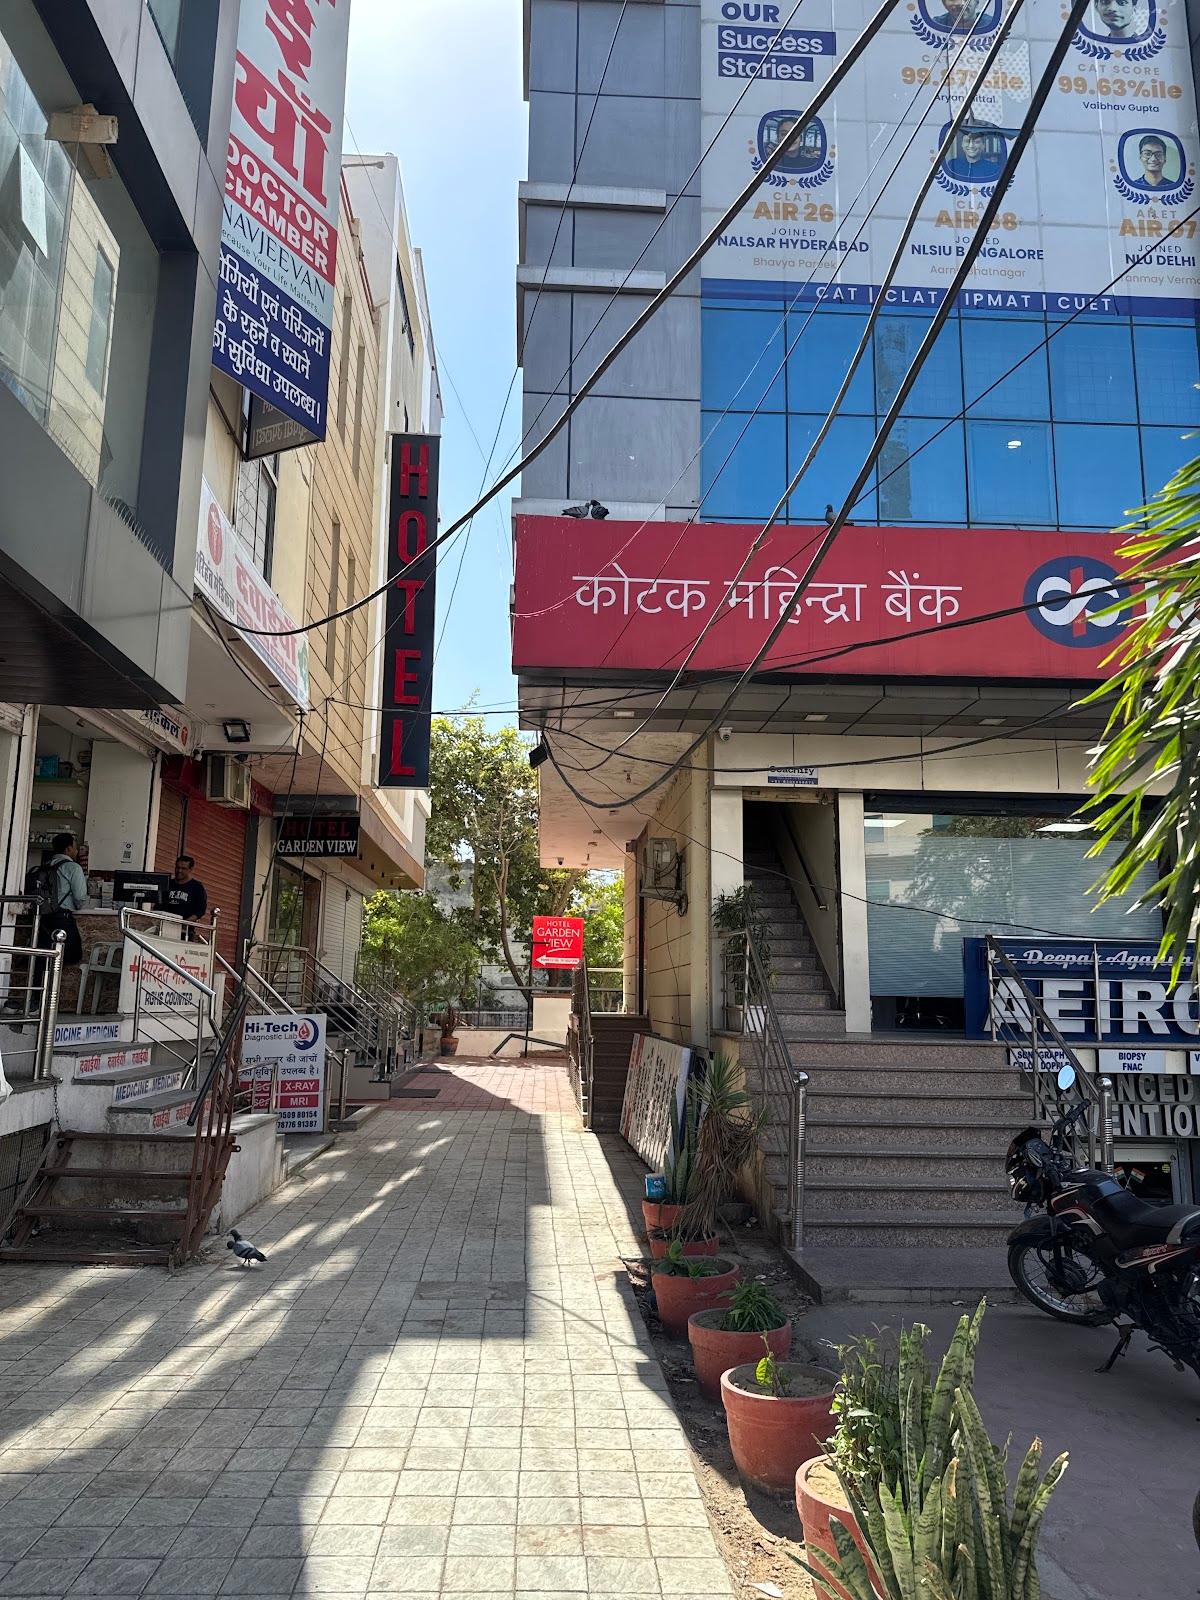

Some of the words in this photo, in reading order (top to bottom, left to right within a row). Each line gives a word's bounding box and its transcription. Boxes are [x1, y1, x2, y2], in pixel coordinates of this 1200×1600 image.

[721, 2, 780, 23] OUR
[721, 29, 824, 53] Success
[721, 57, 806, 80] Stories
[959, 56, 1008, 67] SCOE
[1078, 63, 1106, 72] CAT
[1112, 65, 1160, 75] SCORE
[1058, 75, 1183, 99] 99.63%ile
[967, 95, 996, 103] ittal
[1082, 101, 1126, 111] Vaibhav
[1128, 103, 1160, 114] Gupta
[227, 137, 329, 251] DOCTOR
[773, 192, 812, 201] CLAT
[753, 201, 799, 221] AIR
[803, 203, 834, 222] 26
[956, 200, 988, 210] CLA
[225, 170, 328, 276] CHAMBER
[934, 209, 979, 230] AIR
[771, 228, 817, 237] JOINED
[1119, 218, 1163, 238] AIR
[717, 236, 776, 249] NALSAR
[779, 238, 870, 253] HYDERABAD
[955, 236, 1000, 246] JOED
[1138, 244, 1182, 253] JOINED
[222, 200, 326, 304] NAVJEEVAN
[222, 228, 250, 256] ecause
[273, 269, 288, 286] Life
[911, 244, 952, 257] NLSIU
[956, 246, 1045, 260] BNGALORE
[1125, 253, 1153, 265] NLU
[1156, 255, 1196, 266] DELHI
[1121, 274, 1164, 286] anmay
[815, 286, 857, 300] CAT
[884, 288, 938, 304] CLAT
[965, 291, 1031, 308] IPMAT
[1057, 296, 1111, 312] CUET
[261, 290, 280, 322] एवं
[281, 305, 325, 357] परिजनों
[223, 289, 238, 324] के
[240, 310, 269, 348] रहने
[270, 332, 280, 358] व
[282, 342, 311, 380] खाने
[228, 337, 272, 387] सुविधा
[572, 561, 710, 618] कोटक
[724, 566, 867, 625] महिन्द्रा
[881, 569, 963, 624] बैंक
[391, 443, 430, 777] HOTEL
[286, 821, 350, 837] HOTEL
[276, 839, 325, 853] GARDEN
[326, 840, 357, 853] VIEW
[546, 920, 570, 928] HOTEL
[536, 927, 580, 938] GARDEN
[543, 938, 574, 948] VIEW
[54, 1026, 82, 1042] DICINE
[86, 1024, 119, 1039] MEDICINE
[245, 1022, 298, 1033] Hi-Tech
[244, 1033, 283, 1041] Diagnostic
[1118, 1052, 1147, 1061] BIOPSY
[1122, 1063, 1143, 1071] FNAC
[115, 1080, 149, 1100] MEDICINE
[152, 1072, 181, 1092] MEDICINE
[285, 1081, 315, 1091] X-RAY
[290, 1097, 309, 1106] MRI
